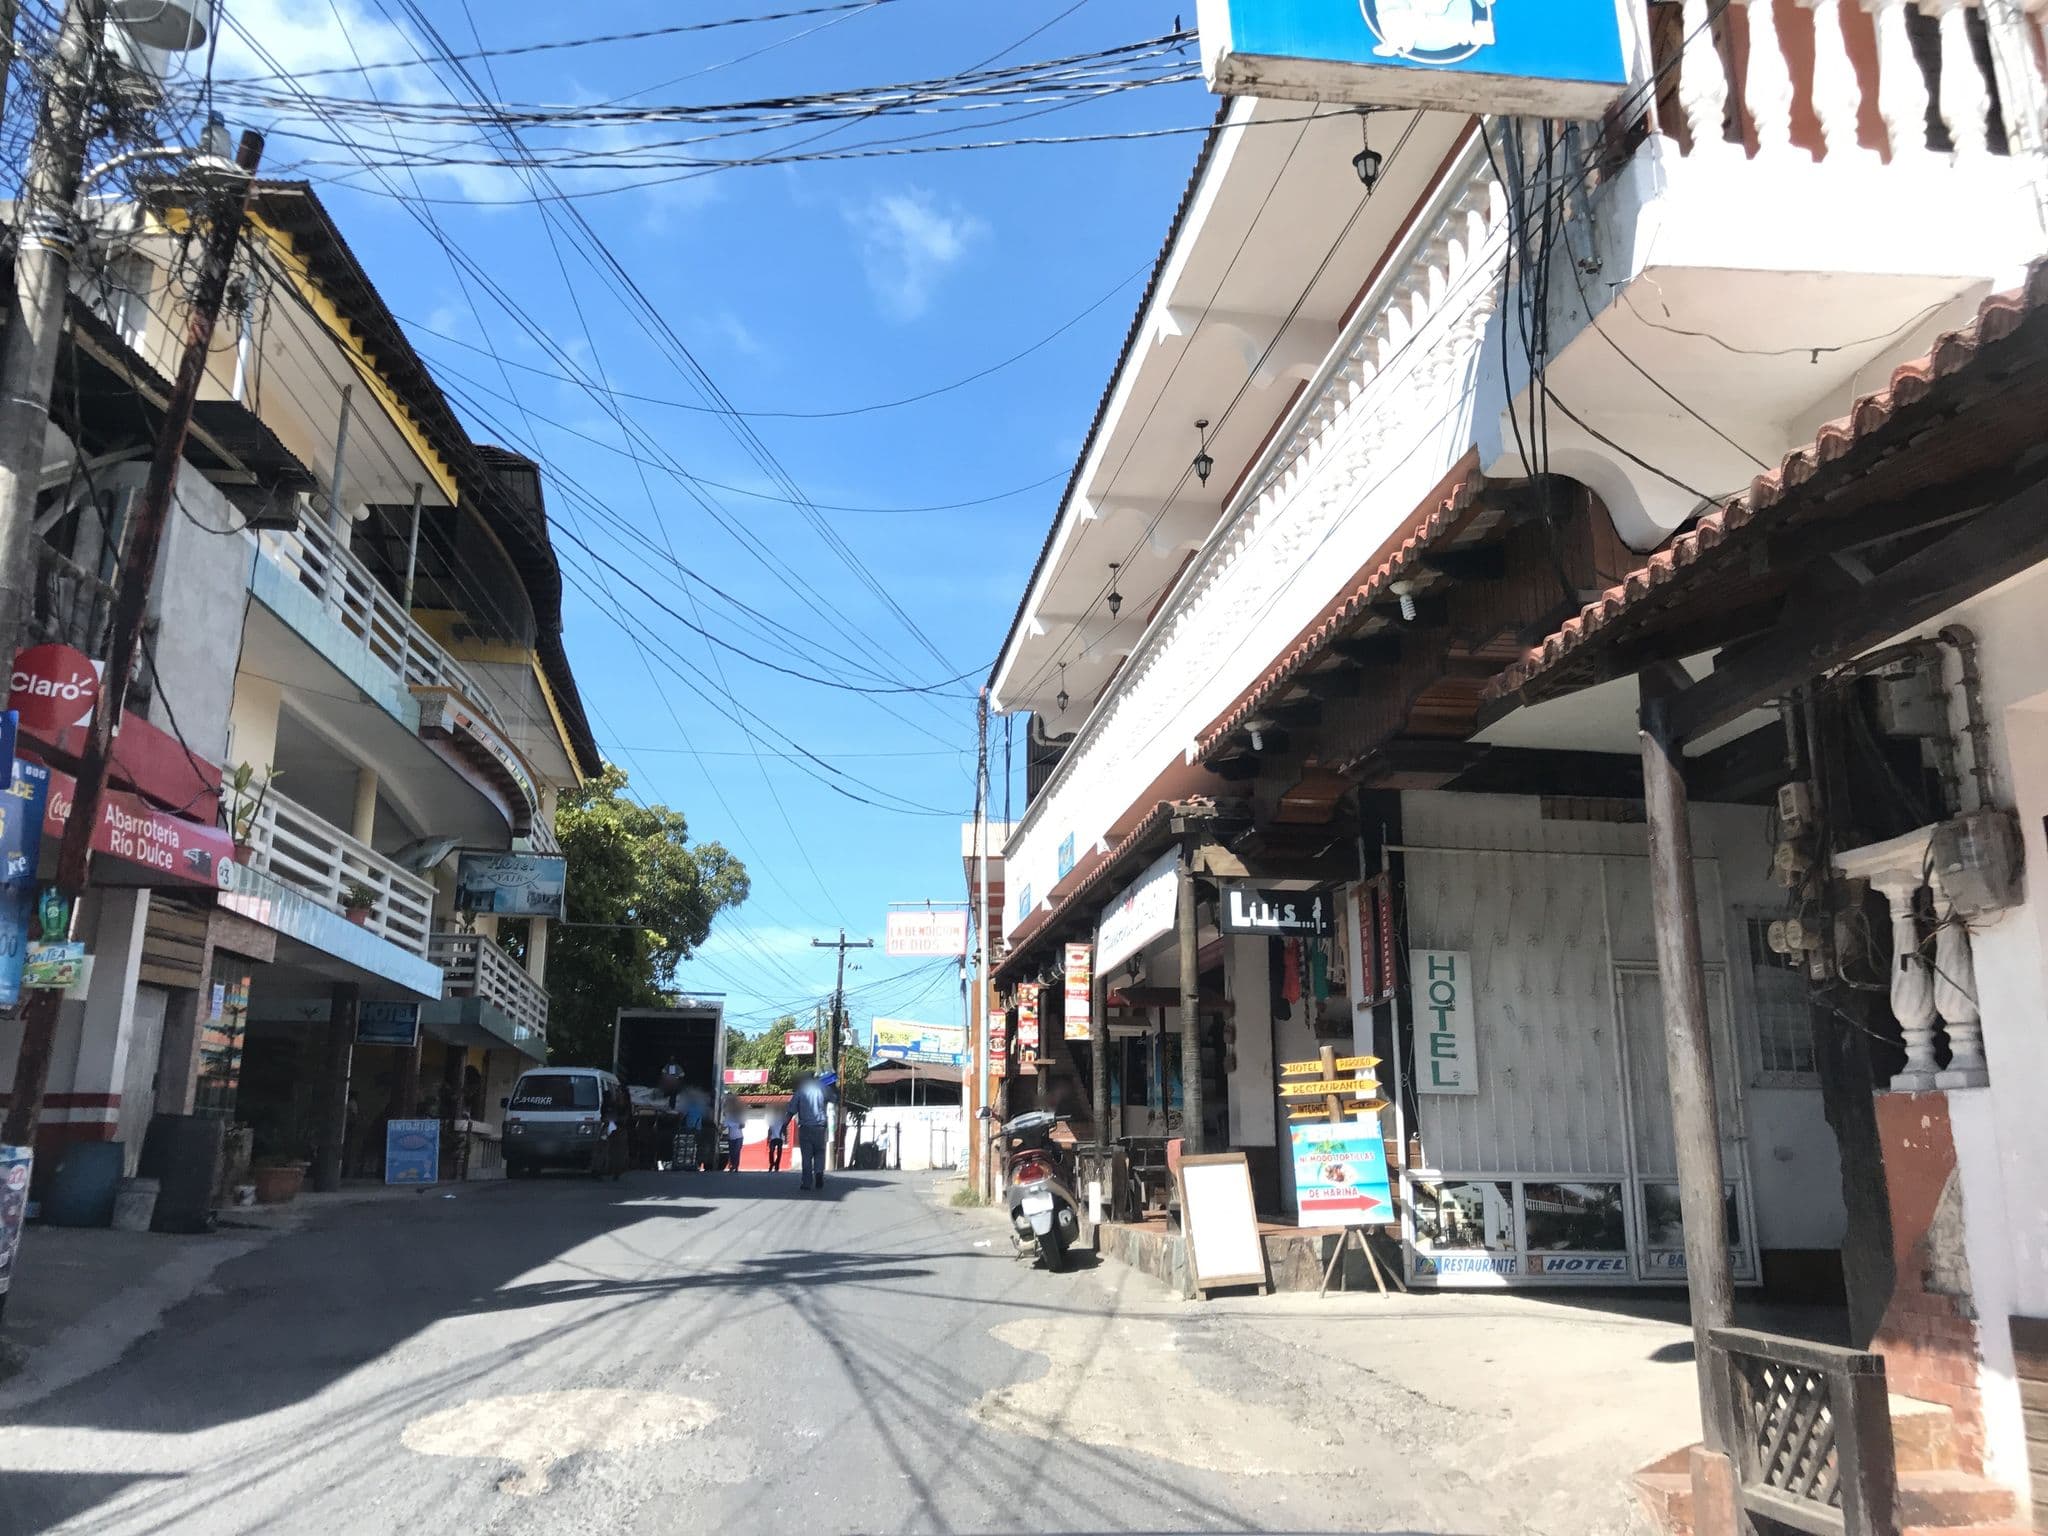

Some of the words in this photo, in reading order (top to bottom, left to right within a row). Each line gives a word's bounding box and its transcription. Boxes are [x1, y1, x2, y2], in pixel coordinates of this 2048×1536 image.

[10, 672, 80, 700] Claro
[104, 803, 180, 849] Abarrotería
[110, 829, 134, 856] Río
[136, 839, 174, 870] Dulce
[1427, 955, 1460, 1087] HOTEL
[1288, 1063, 1319, 1073] HOTEL
[1323, 1187, 1358, 1197] HARINA
[1443, 1258, 1516, 1273] RESTAURANTE
[1547, 1259, 1625, 1271] HOTEL
